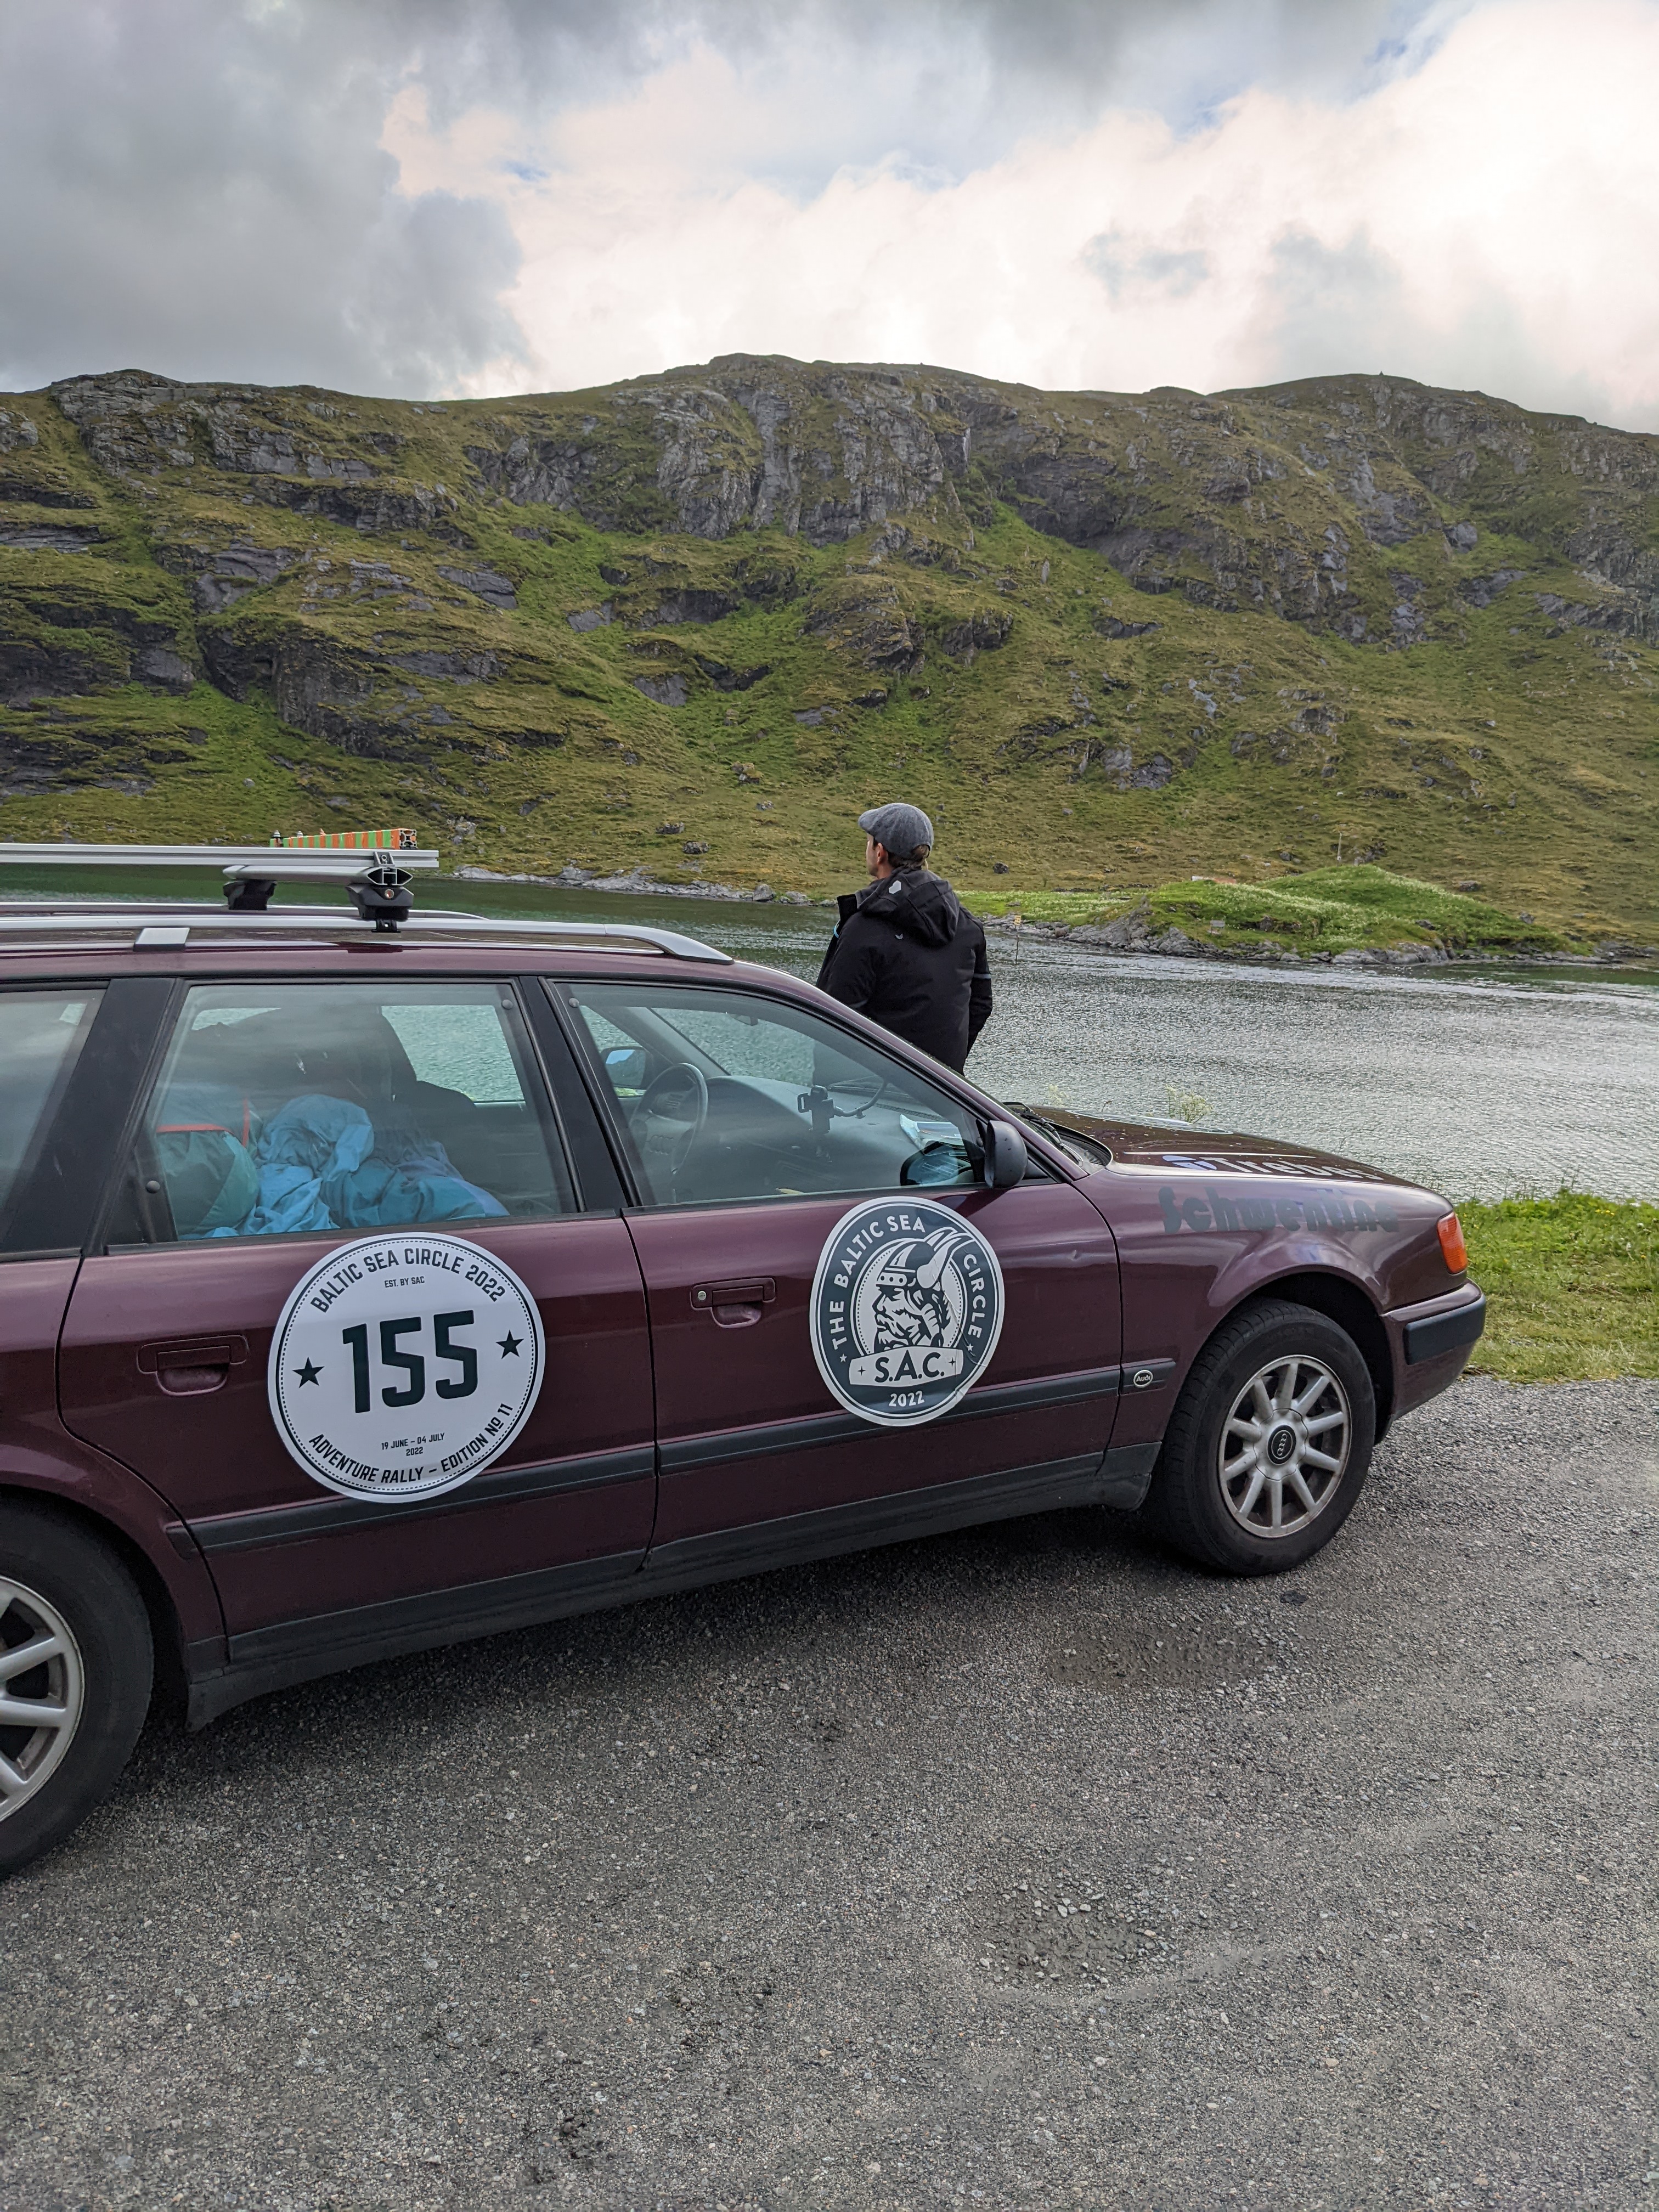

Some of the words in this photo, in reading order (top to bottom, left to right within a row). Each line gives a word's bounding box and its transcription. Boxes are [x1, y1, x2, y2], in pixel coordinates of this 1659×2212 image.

[1199, 1156, 1384, 1181] Trebes
[887, 1215, 926, 1233] SEA
[834, 1221, 884, 1288] BALTIC
[311, 1263, 363, 1313] BALTIC
[363, 1250, 399, 1273] SEA
[404, 1248, 465, 1274] CIRCLE
[465, 1264, 506, 1302] 2022
[385, 1279, 399, 1288] EST.
[400, 1277, 409, 1286] BY
[411, 1276, 425, 1284] SAC
[963, 1254, 986, 1339] CIRCLE
[830, 1301, 847, 1350] THE
[342, 1310, 478, 1414] 155
[875, 1350, 945, 1383] S.A.C.
[889, 1390, 925, 1407] 2022
[309, 1434, 380, 1482] ADVENTURE
[381, 1466, 424, 1483] RALLY
[441, 1433, 489, 1472] EDITION
[497, 1403, 513, 1416] 11
[381, 1442, 388, 1450] 19
[391, 1438, 409, 1449] JUNE
[417, 1435, 427, 1444] 04
[428, 1432, 445, 1442] JULY
[406, 1446, 424, 1456] 2022
